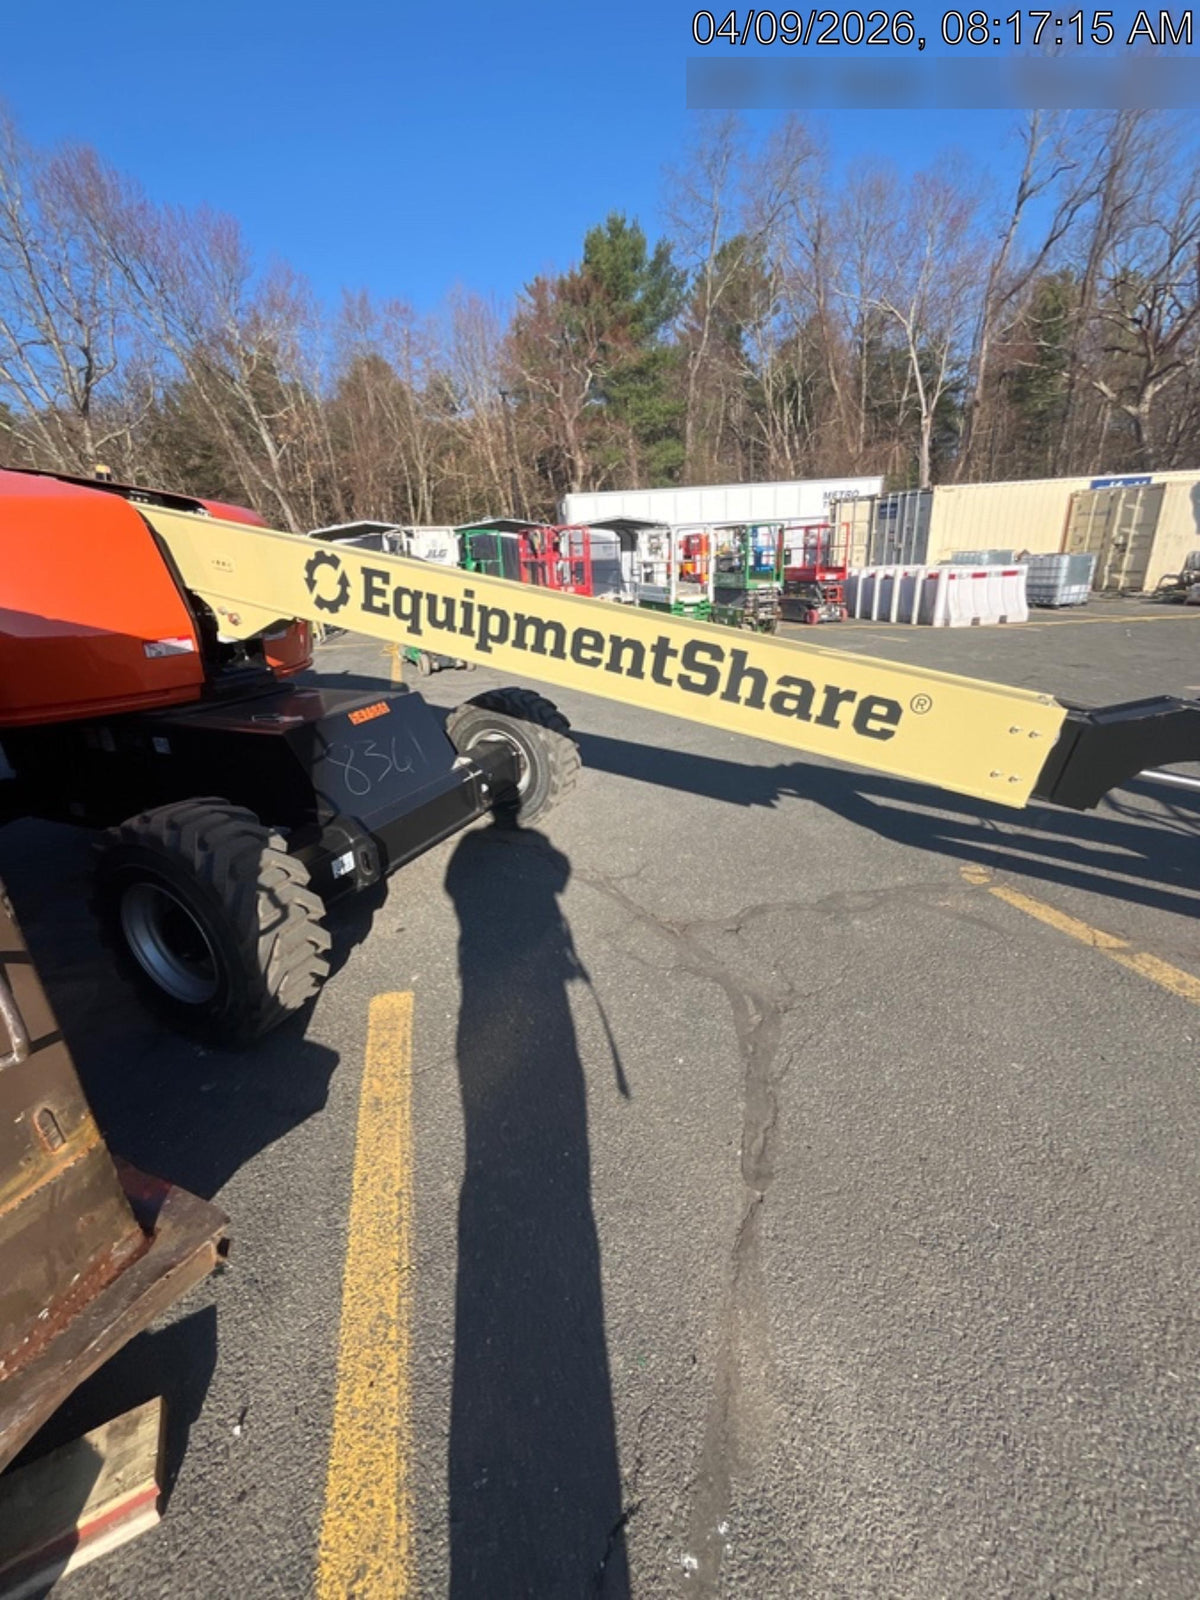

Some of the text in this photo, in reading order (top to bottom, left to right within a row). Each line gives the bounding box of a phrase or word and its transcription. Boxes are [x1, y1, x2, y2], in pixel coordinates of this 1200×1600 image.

[823, 489, 859, 500] METRO
[425, 549, 448, 558] JLG
[361, 566, 903, 741] EquipmentShare
